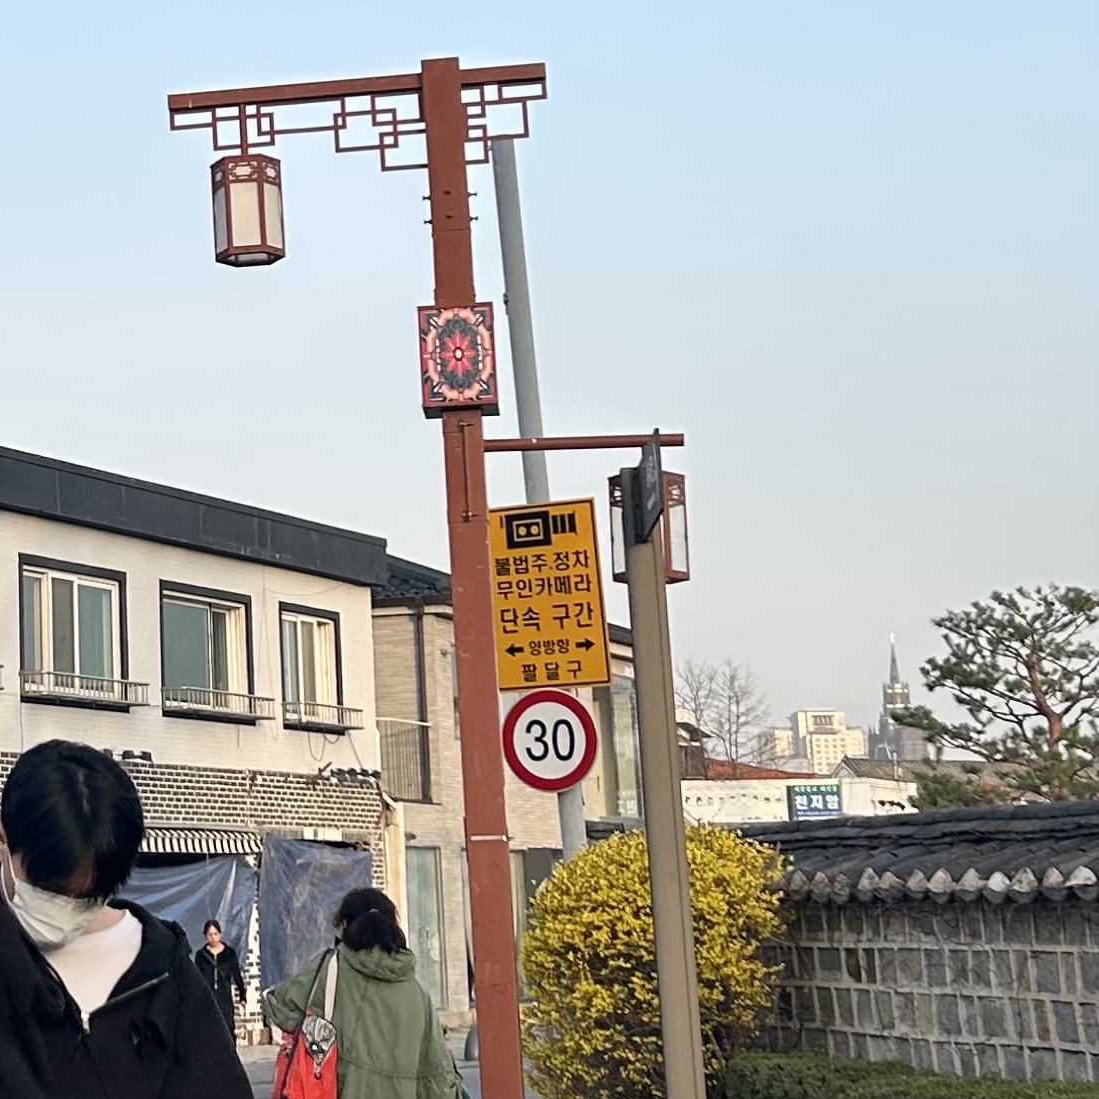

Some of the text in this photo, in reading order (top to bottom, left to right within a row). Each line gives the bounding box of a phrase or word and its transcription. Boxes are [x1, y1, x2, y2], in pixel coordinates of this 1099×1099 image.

[497, 573, 592, 600] 무인카메라
[500, 601, 593, 634] 단속 구간
[528, 638, 570, 656] 양방향
[525, 718, 575, 762] 30
